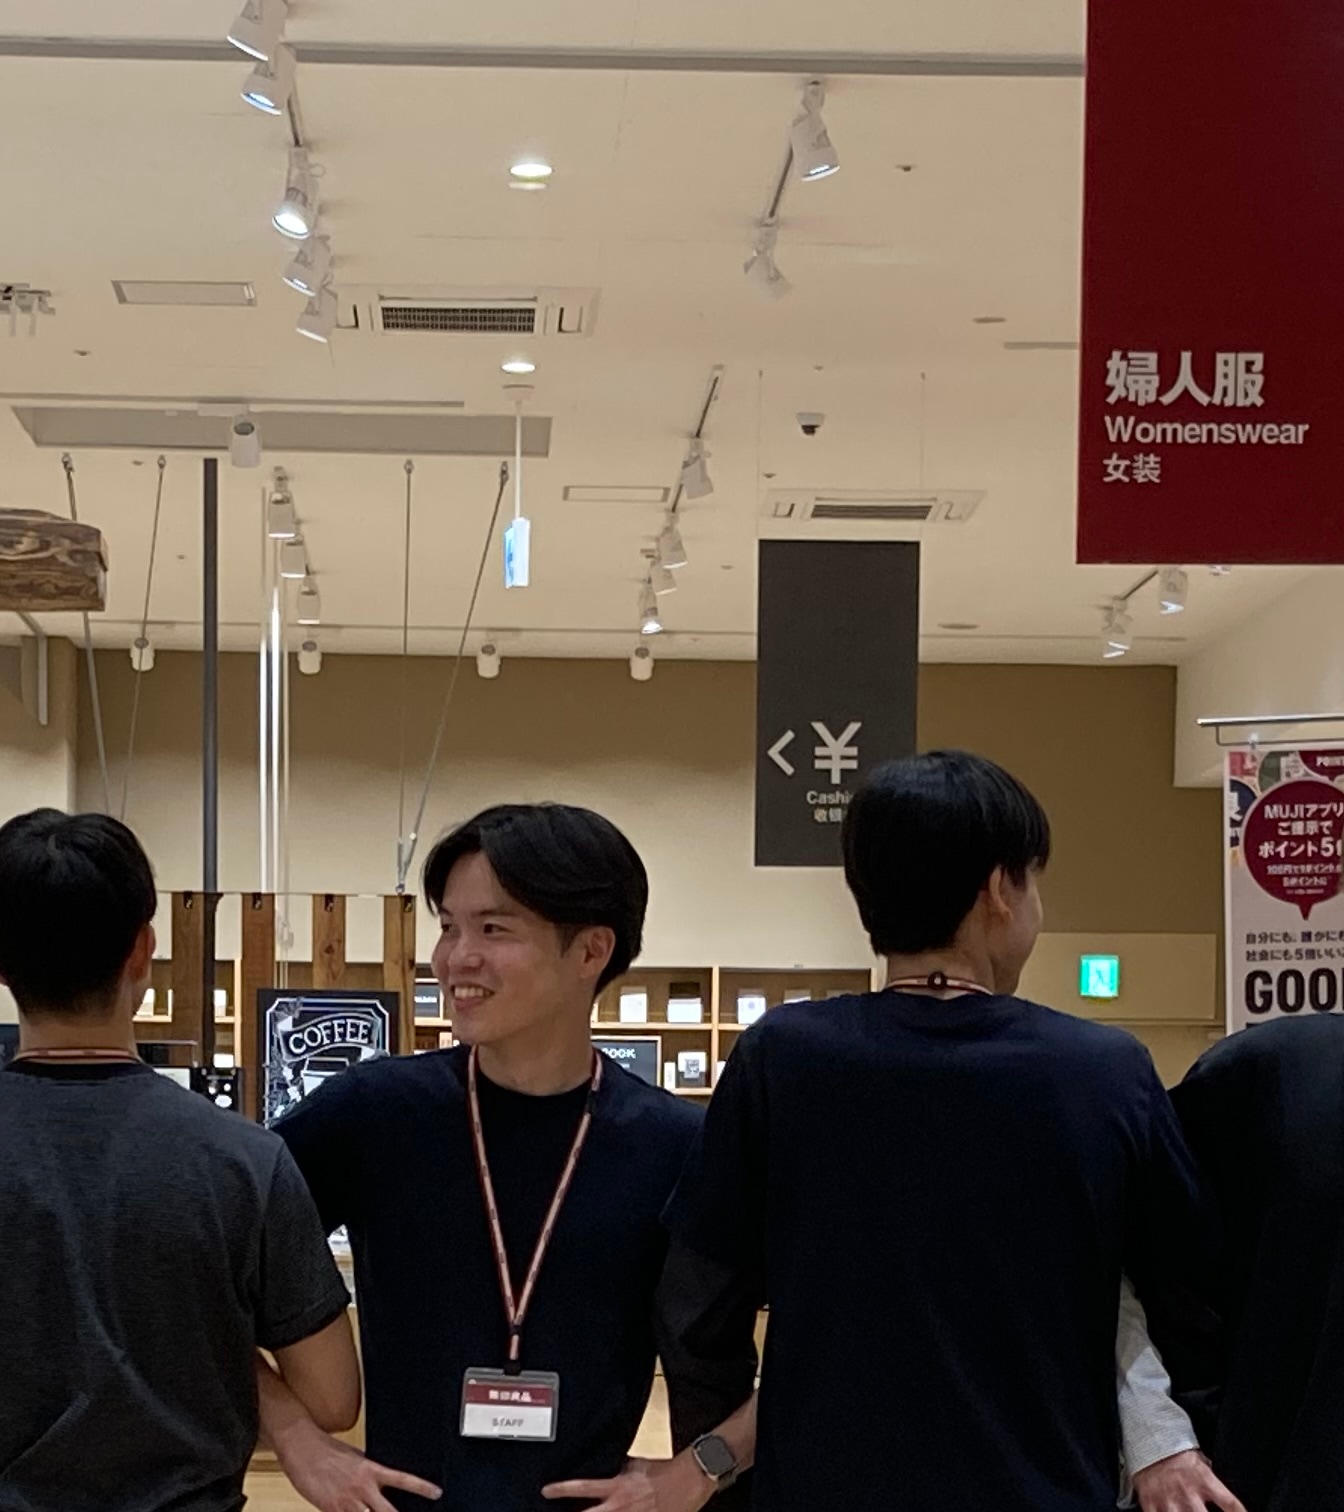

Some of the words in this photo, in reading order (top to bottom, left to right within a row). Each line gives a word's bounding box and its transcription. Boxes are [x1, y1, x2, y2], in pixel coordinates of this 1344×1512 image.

[1106, 350, 1264, 408] 婦人服
[1104, 415, 1309, 445] Womenswear
[1103, 453, 1161, 483] 女装
[807, 790, 855, 804] Cashi
[1264, 802, 1344, 819] MUJIアプリ
[289, 1018, 371, 1054] COFFEE
[492, 1418, 524, 1427] STAFF
